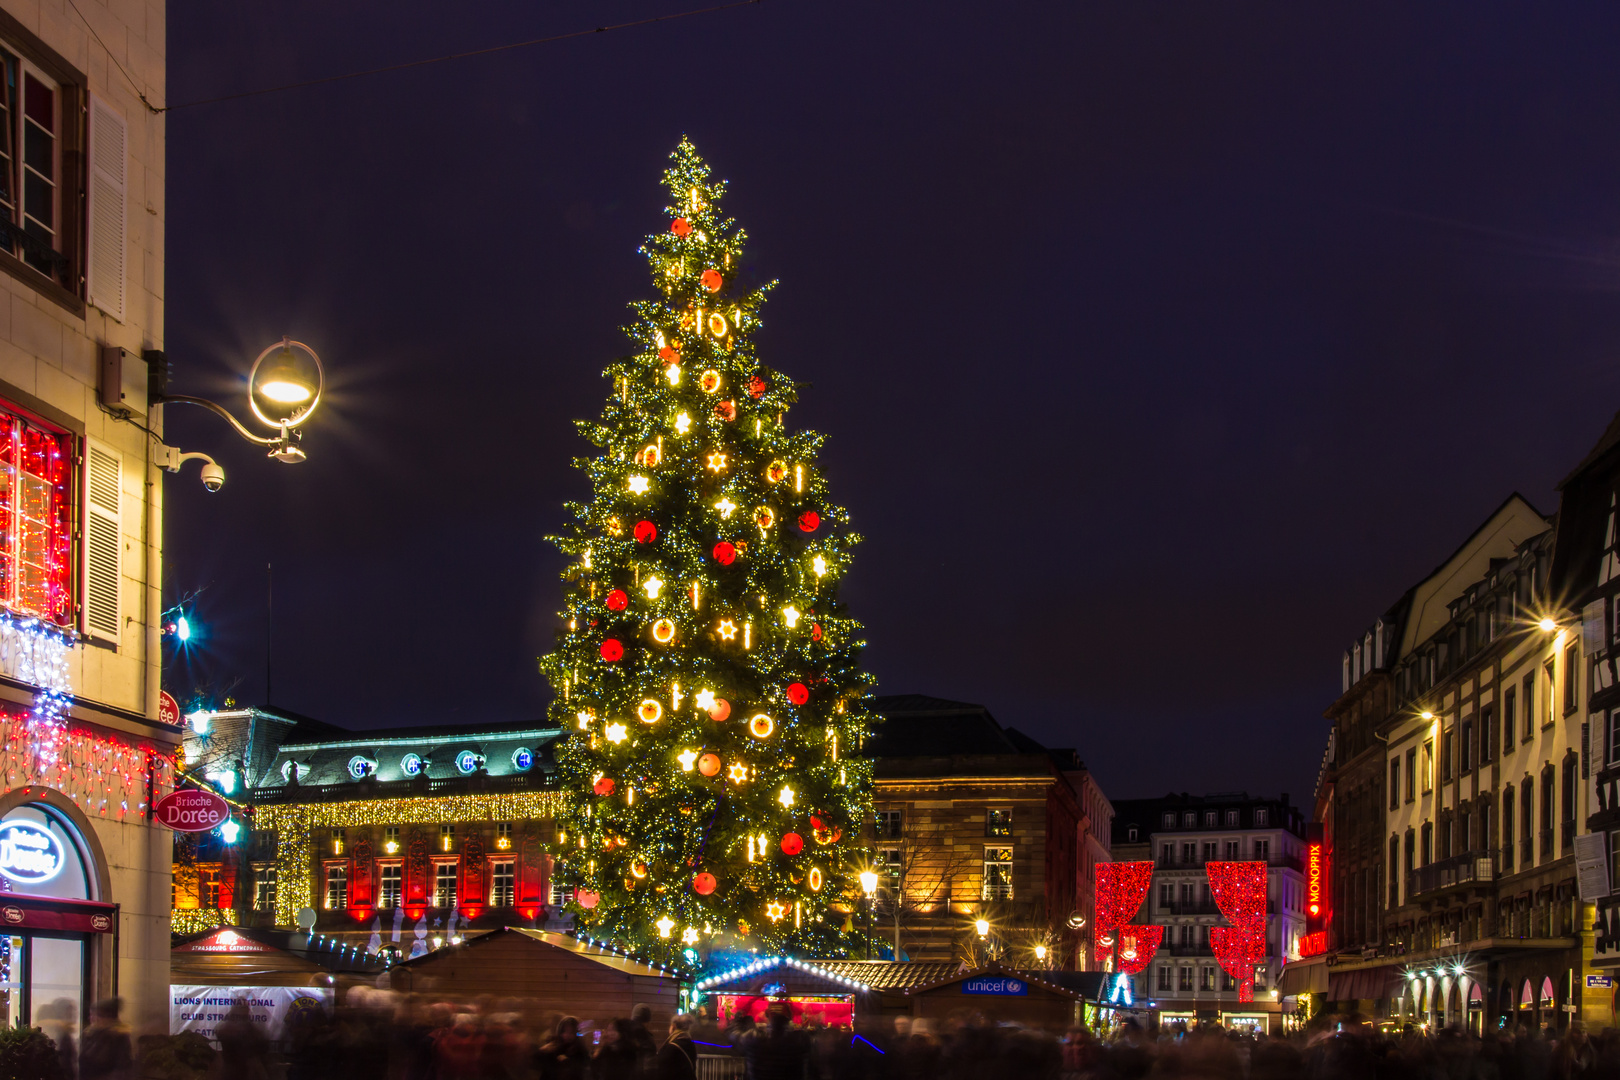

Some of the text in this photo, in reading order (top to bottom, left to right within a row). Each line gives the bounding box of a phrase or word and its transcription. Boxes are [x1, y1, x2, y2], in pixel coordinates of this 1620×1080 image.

[175, 796, 212, 807] Brioche
[166, 805, 219, 824] Dorée
[1310, 845, 1320, 902] MONOPRIX
[967, 979, 1006, 992] unicef
[174, 997, 275, 1007] LIONS INTERNATIONAL
[181, 1013, 267, 1023] CLUB STRAURG
